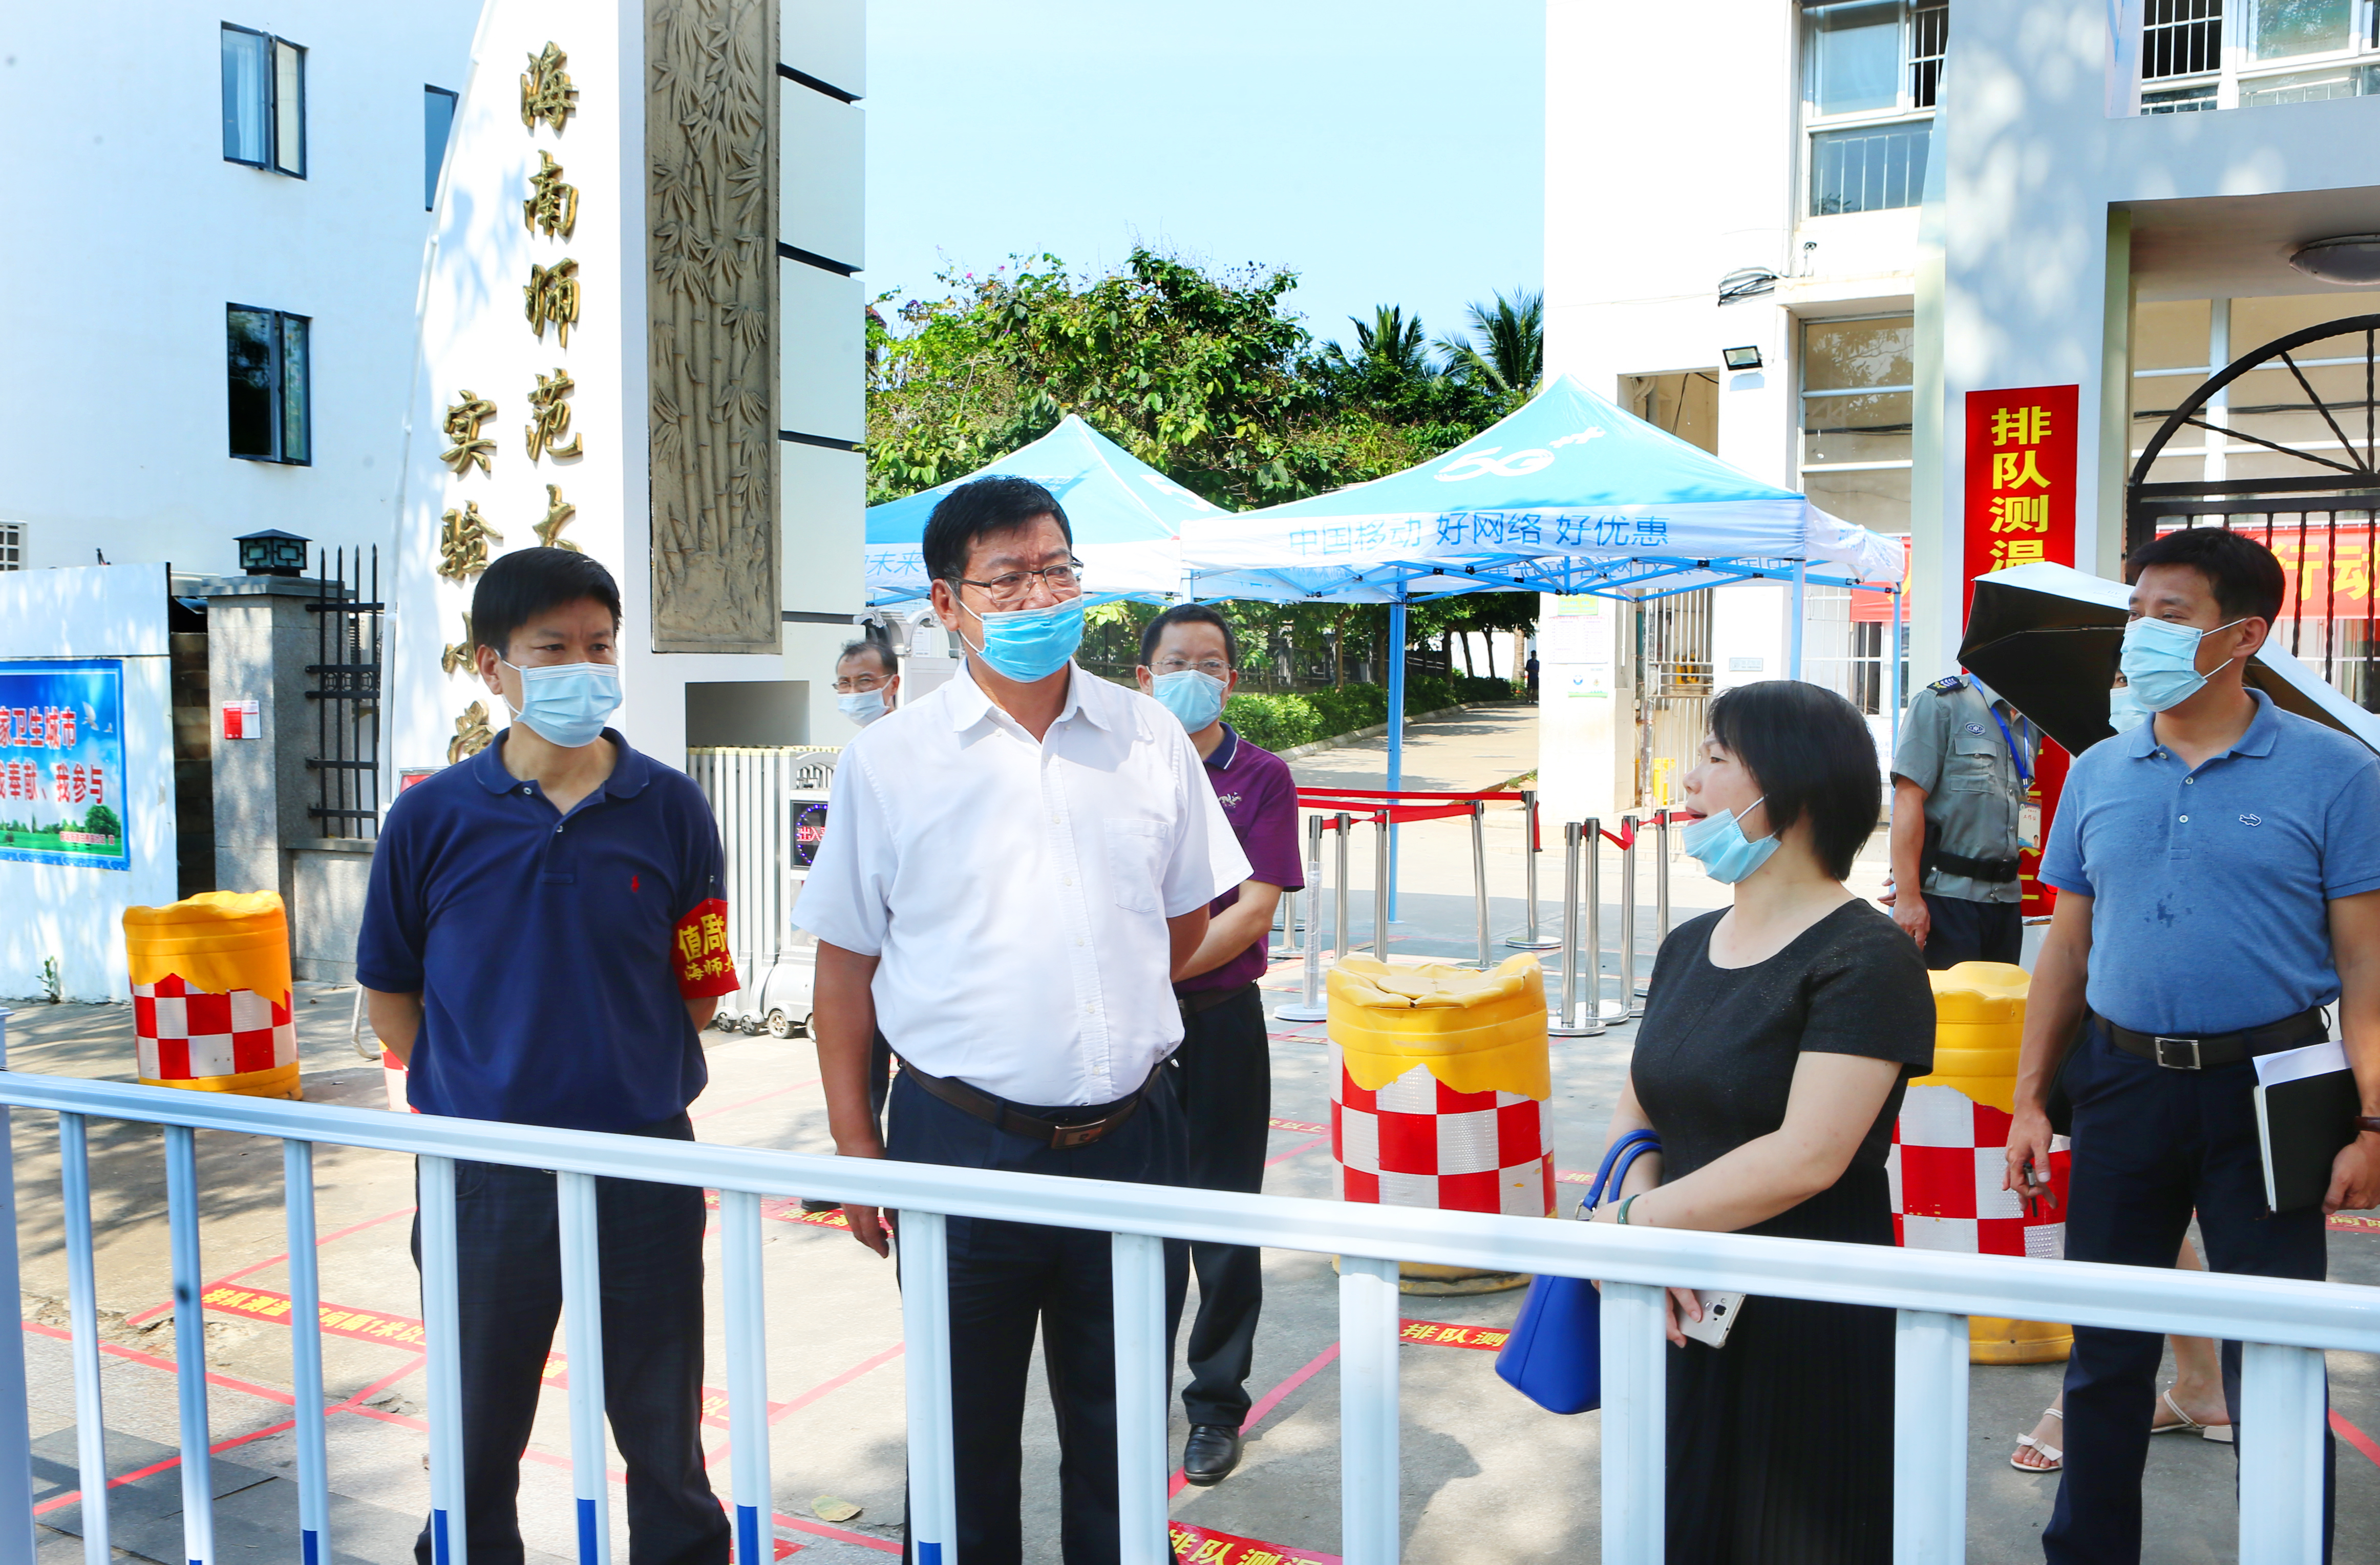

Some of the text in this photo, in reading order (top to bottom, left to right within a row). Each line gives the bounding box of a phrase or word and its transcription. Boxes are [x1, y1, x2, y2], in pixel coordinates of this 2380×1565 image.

[1289, 512, 1669, 557] 中国移动 好网络 好优惠
[865, 550, 927, 576] 未来
[2270, 541, 2380, 601] 行动
[0, 706, 76, 749] 家卫生城市
